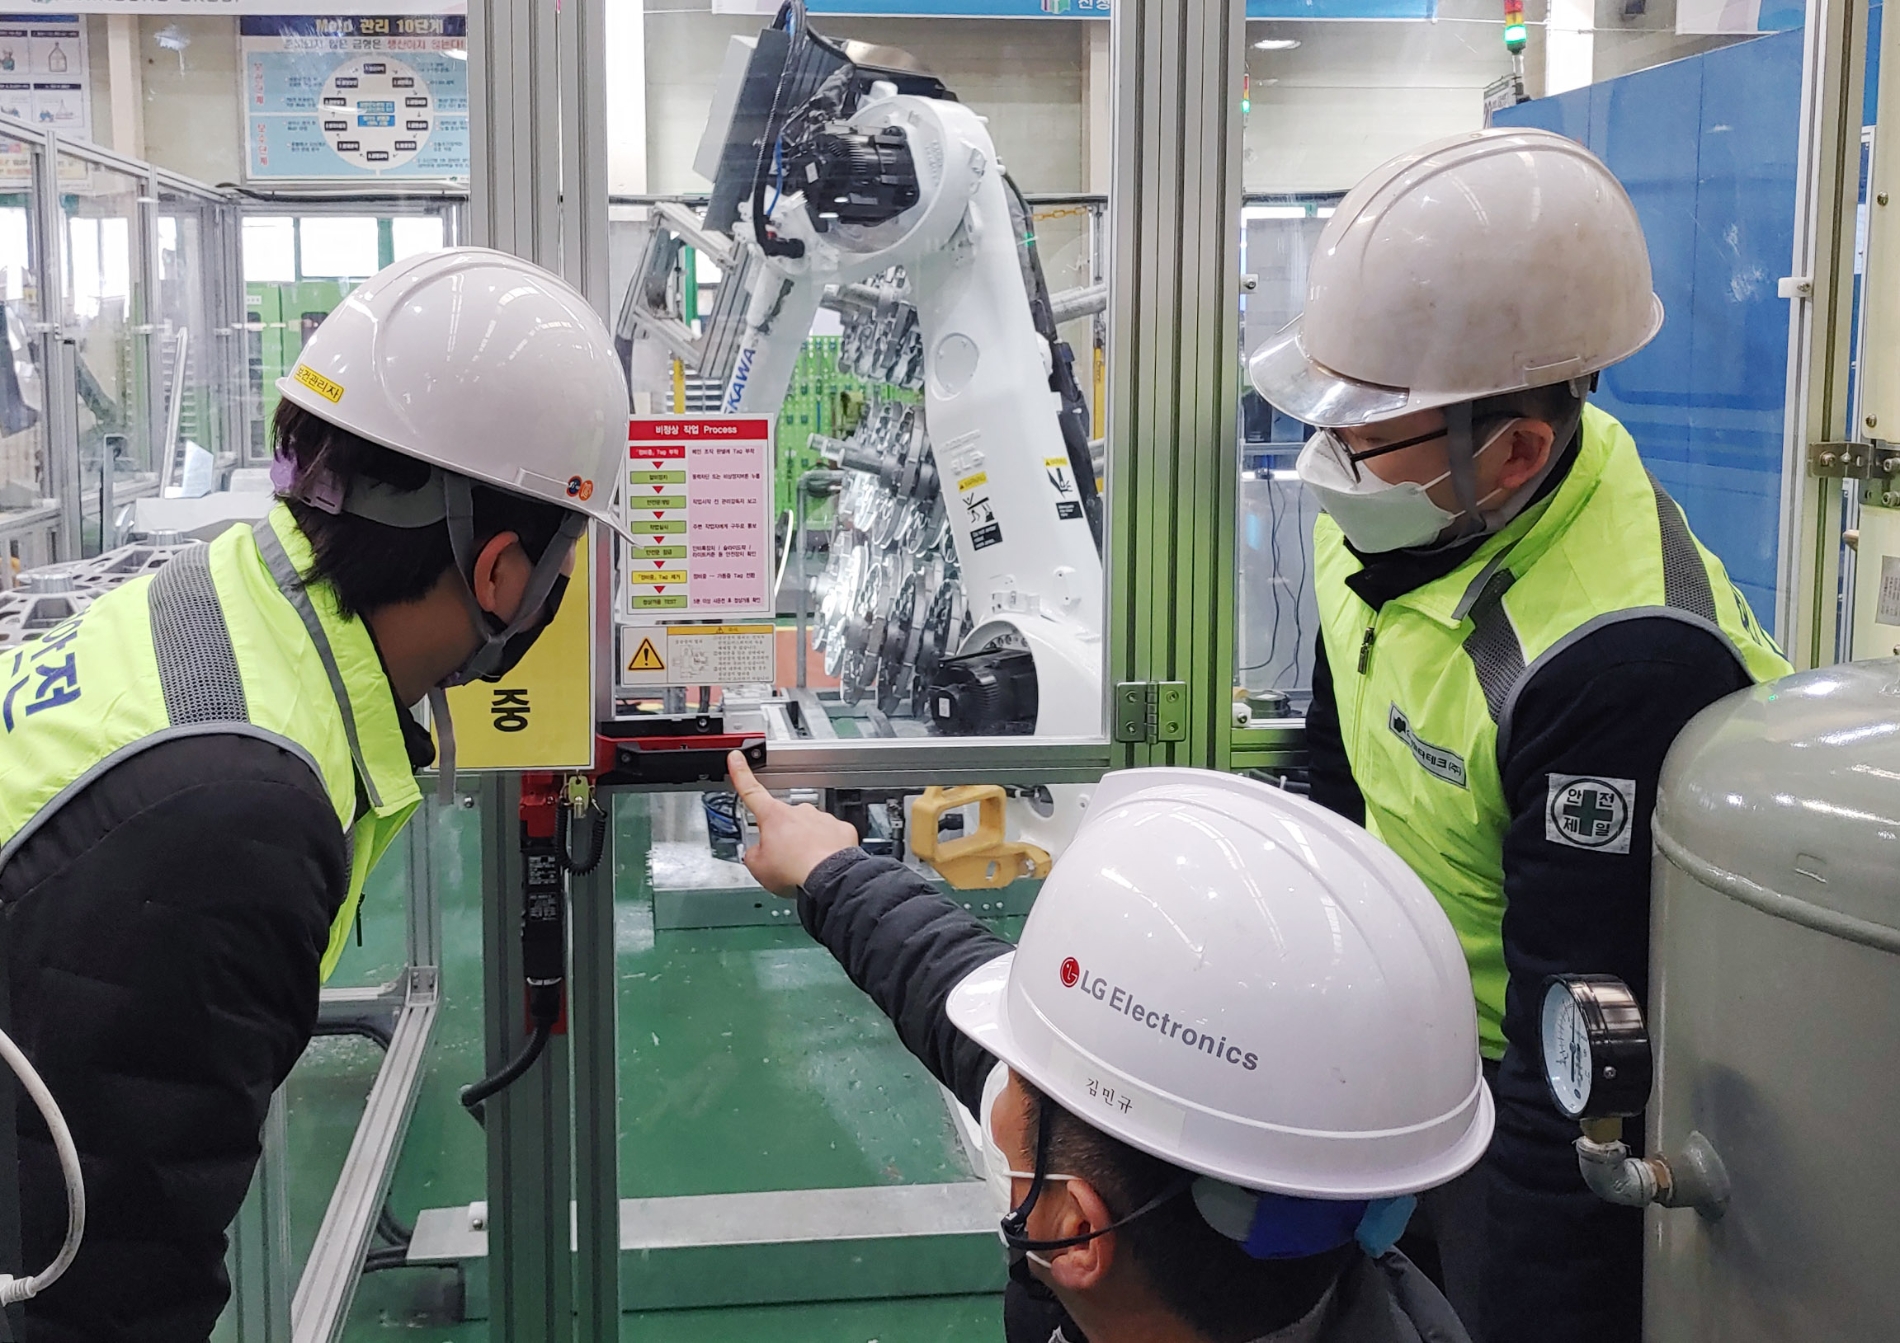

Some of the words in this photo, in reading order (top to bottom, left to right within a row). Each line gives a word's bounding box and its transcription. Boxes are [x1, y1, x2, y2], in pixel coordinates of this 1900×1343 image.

[359, 19, 390, 33] 관리
[396, 18, 444, 34] 10단계
[353, 37, 382, 49] 금형은
[296, 368, 340, 399] 보건관리자
[723, 348, 756, 414] KAWA
[655, 425, 679, 435] 비정상
[683, 425, 699, 435] 작업
[703, 426, 738, 434] Process
[1080, 970, 1108, 1000] LG
[1109, 986, 1259, 1071] Electronics
[1086, 1078, 1132, 1114] 김민규
